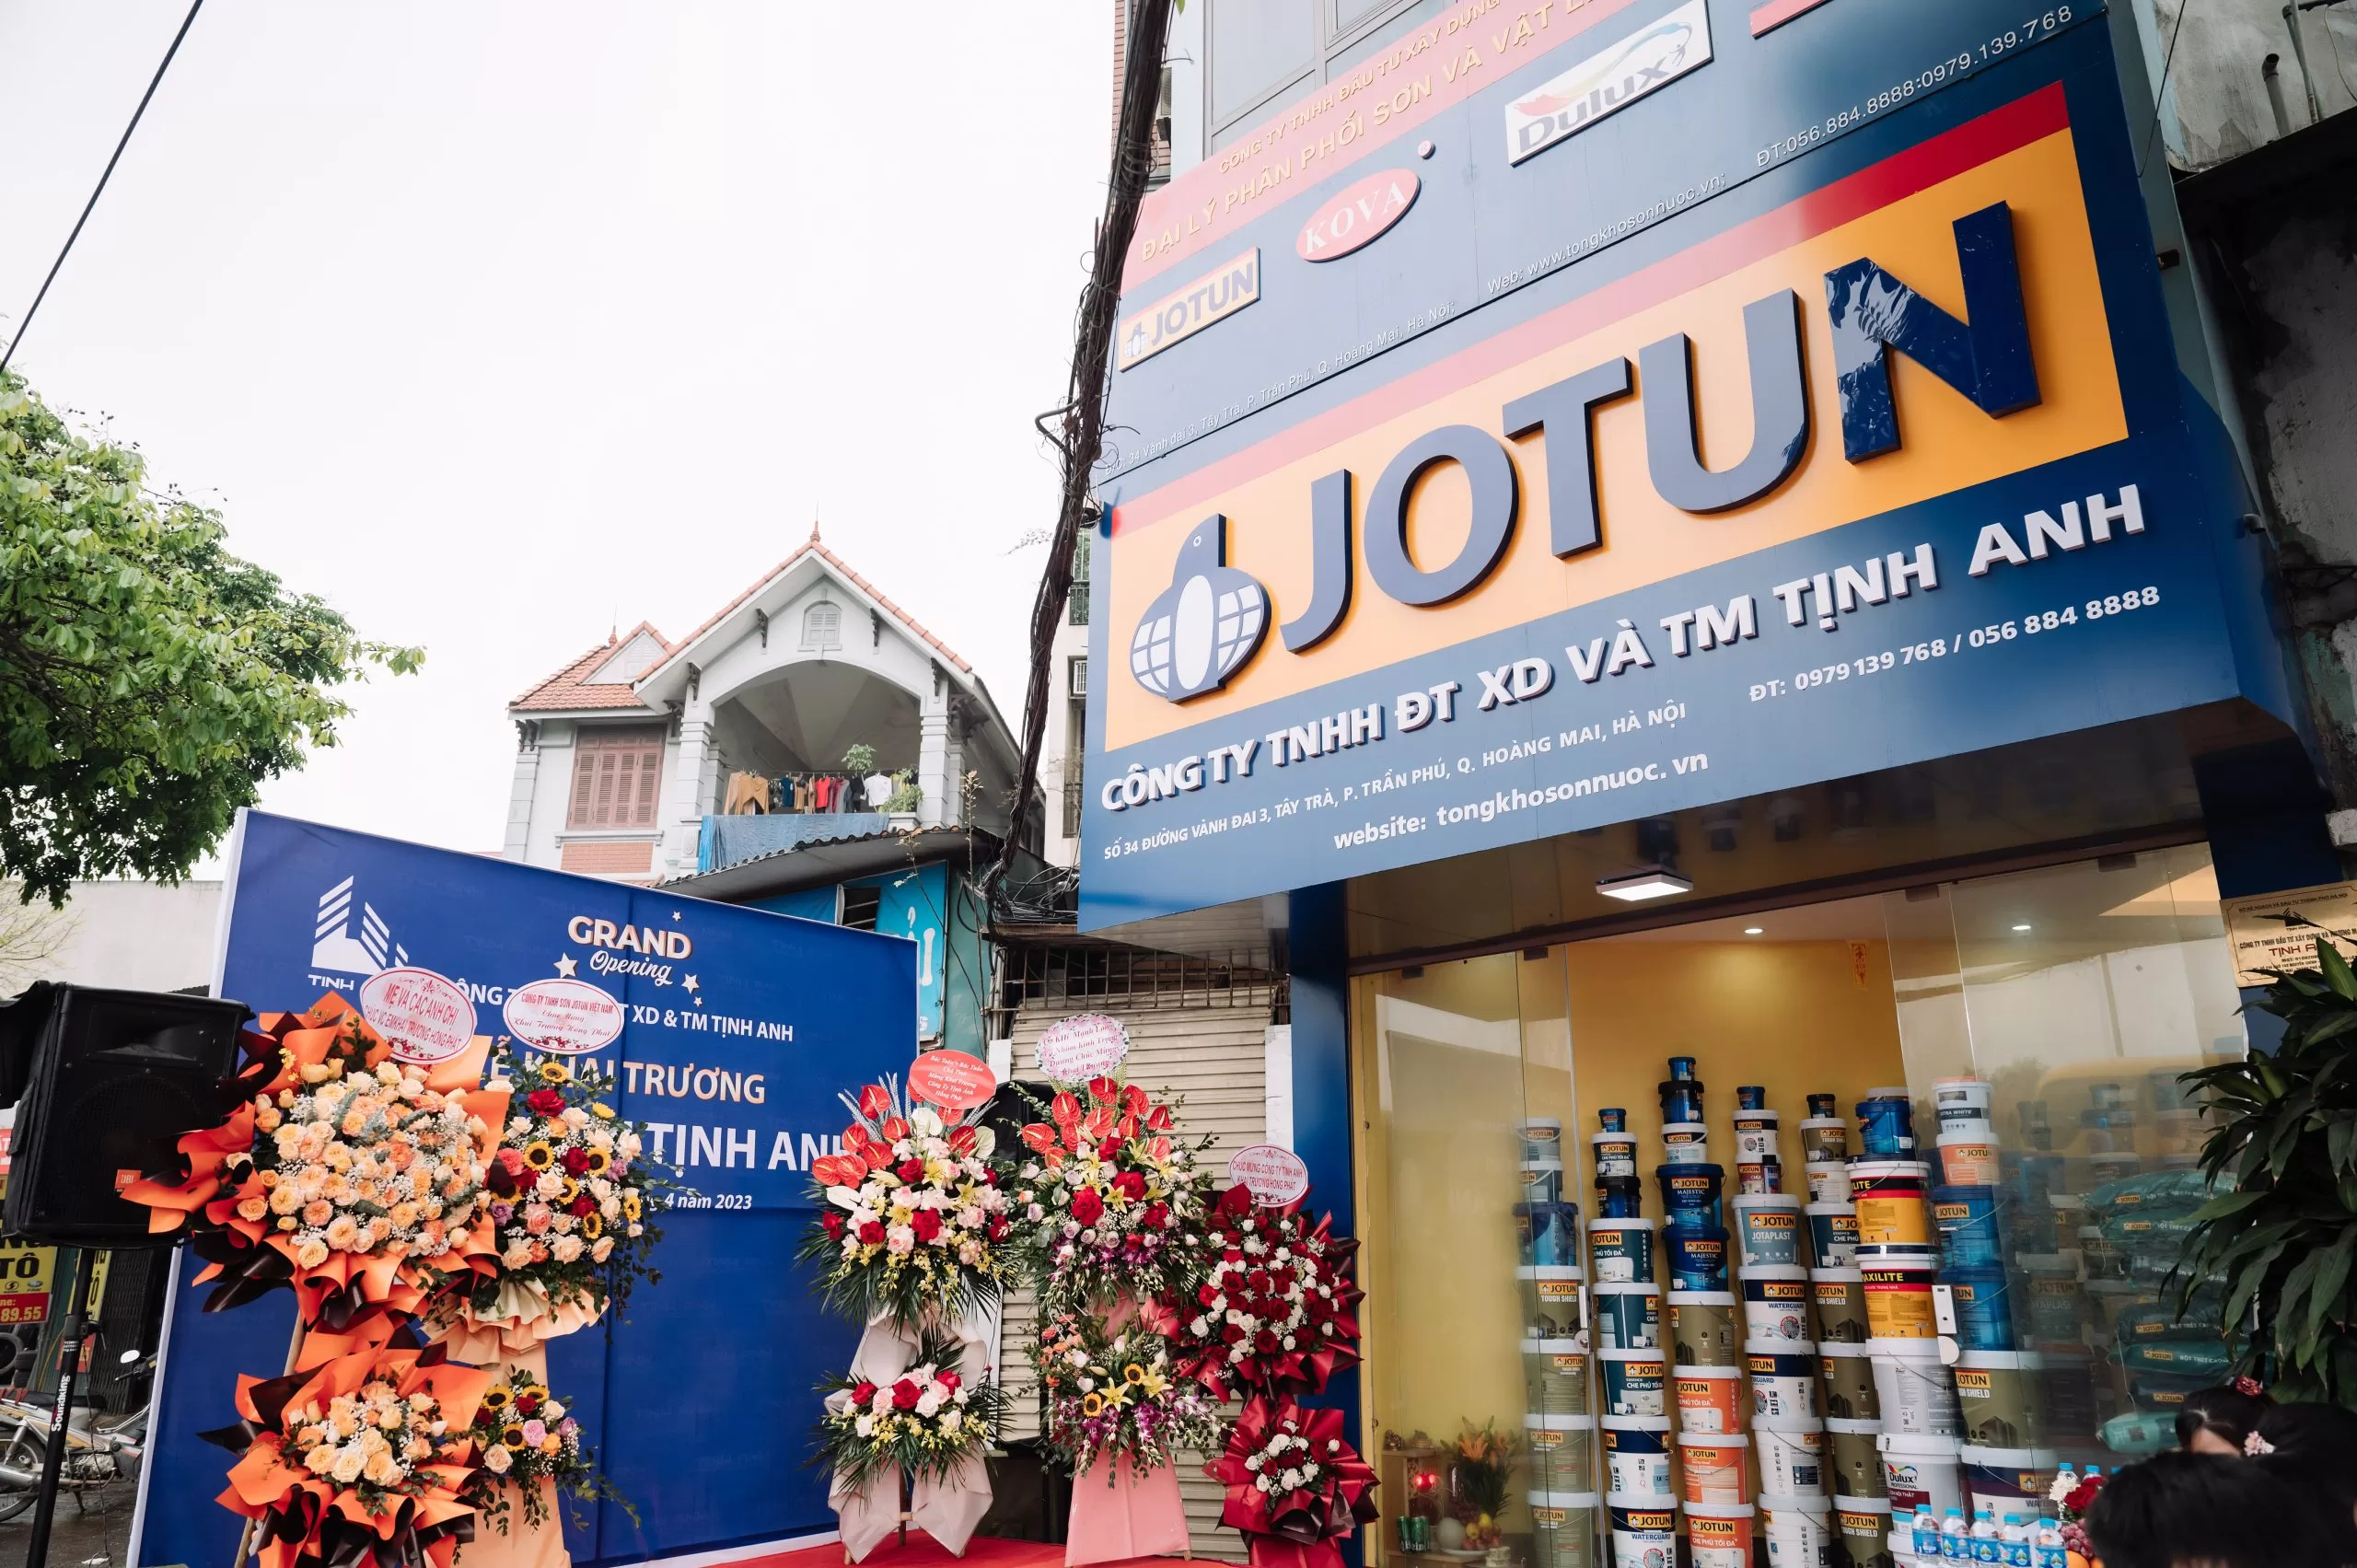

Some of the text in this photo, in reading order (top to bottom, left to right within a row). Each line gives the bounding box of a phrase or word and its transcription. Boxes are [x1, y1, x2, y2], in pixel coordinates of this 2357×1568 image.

[1218, 140, 1262, 175] CÔNG
[1267, 123, 1286, 145] TY
[1289, 96, 1334, 131] TNHH
[1340, 70, 1374, 102] ĐẦU
[1377, 51, 1402, 76] TƯ
[1406, 28, 1442, 62] XÂY
[1518, 56, 1669, 153] Dulux
[1142, 1, 1553, 261] ĐẠI LÝ PHÂN PHỐI SƠN VÀ VẬT
[1305, 180, 1407, 255] KOVA
[1487, 268, 1525, 295] Web:
[1151, 261, 1253, 346] JOTUN
[1129, 449, 1140, 464] 34
[1248, 397, 1257, 408] P.
[1318, 360, 1331, 375] Q.
[1376, 323, 1403, 347] Mai,
[1280, 201, 2041, 656] JOTUN
[1101, 483, 2145, 811] CÔNG TY TNHH ĐT XD VÀ TM TỊNH ANH
[1749, 585, 2161, 702] ĐT: 0979 139 768 / 056 884 8888
[1104, 699, 1687, 860] SỐ 34 ĐƯỜNG VÀNH ĐAI 3, TÂY TRÀ, P. TRẦN PHÚ, Q. HOÀNG MAI, HÀ NỘI
[1334, 817, 1426, 850] website:
[568, 915, 692, 959] GRAND
[2269, 945, 2301, 957] TỊNH
[589, 950, 673, 986] Opening
[308, 974, 354, 991] TINH
[572, 1000, 588, 1010] JOTUN
[633, 1005, 794, 1041] XD & TM TỊNH ANH
[623, 1061, 765, 1104] TRƯƠNG
[645, 1121, 756, 1178] TỊNH
[665, 1192, 674, 1207] 4
[715, 1194, 752, 1209] 2023
[1940, 1208, 1967, 1216] JOTUN
[1764, 1217, 1794, 1226] JOTUN
[1550, 1284, 1576, 1293] JOTUN
[1778, 1286, 1803, 1295] JOTUN
[1563, 1357, 1583, 1365] JOTUN
[1639, 1365, 1662, 1375] JOTUN
[1640, 1380, 1651, 1388] PHỦ
[1680, 1384, 1708, 1392] JOTUN
[1968, 1388, 1990, 1398] SHIELD
[52, 1376, 70, 1432] Soundking
[1536, 1434, 1561, 1442] JOTUN
[1889, 1472, 1914, 1483] Dulux
[1538, 1511, 1563, 1519] JOTUN
[1641, 1516, 1670, 1526] JOTUN
[1846, 1517, 1875, 1527] JOTUN
[1700, 1522, 1733, 1532] JOTUN
[1856, 1528, 1878, 1538] SHIELD
[1714, 1538, 1725, 1546] TỐI
